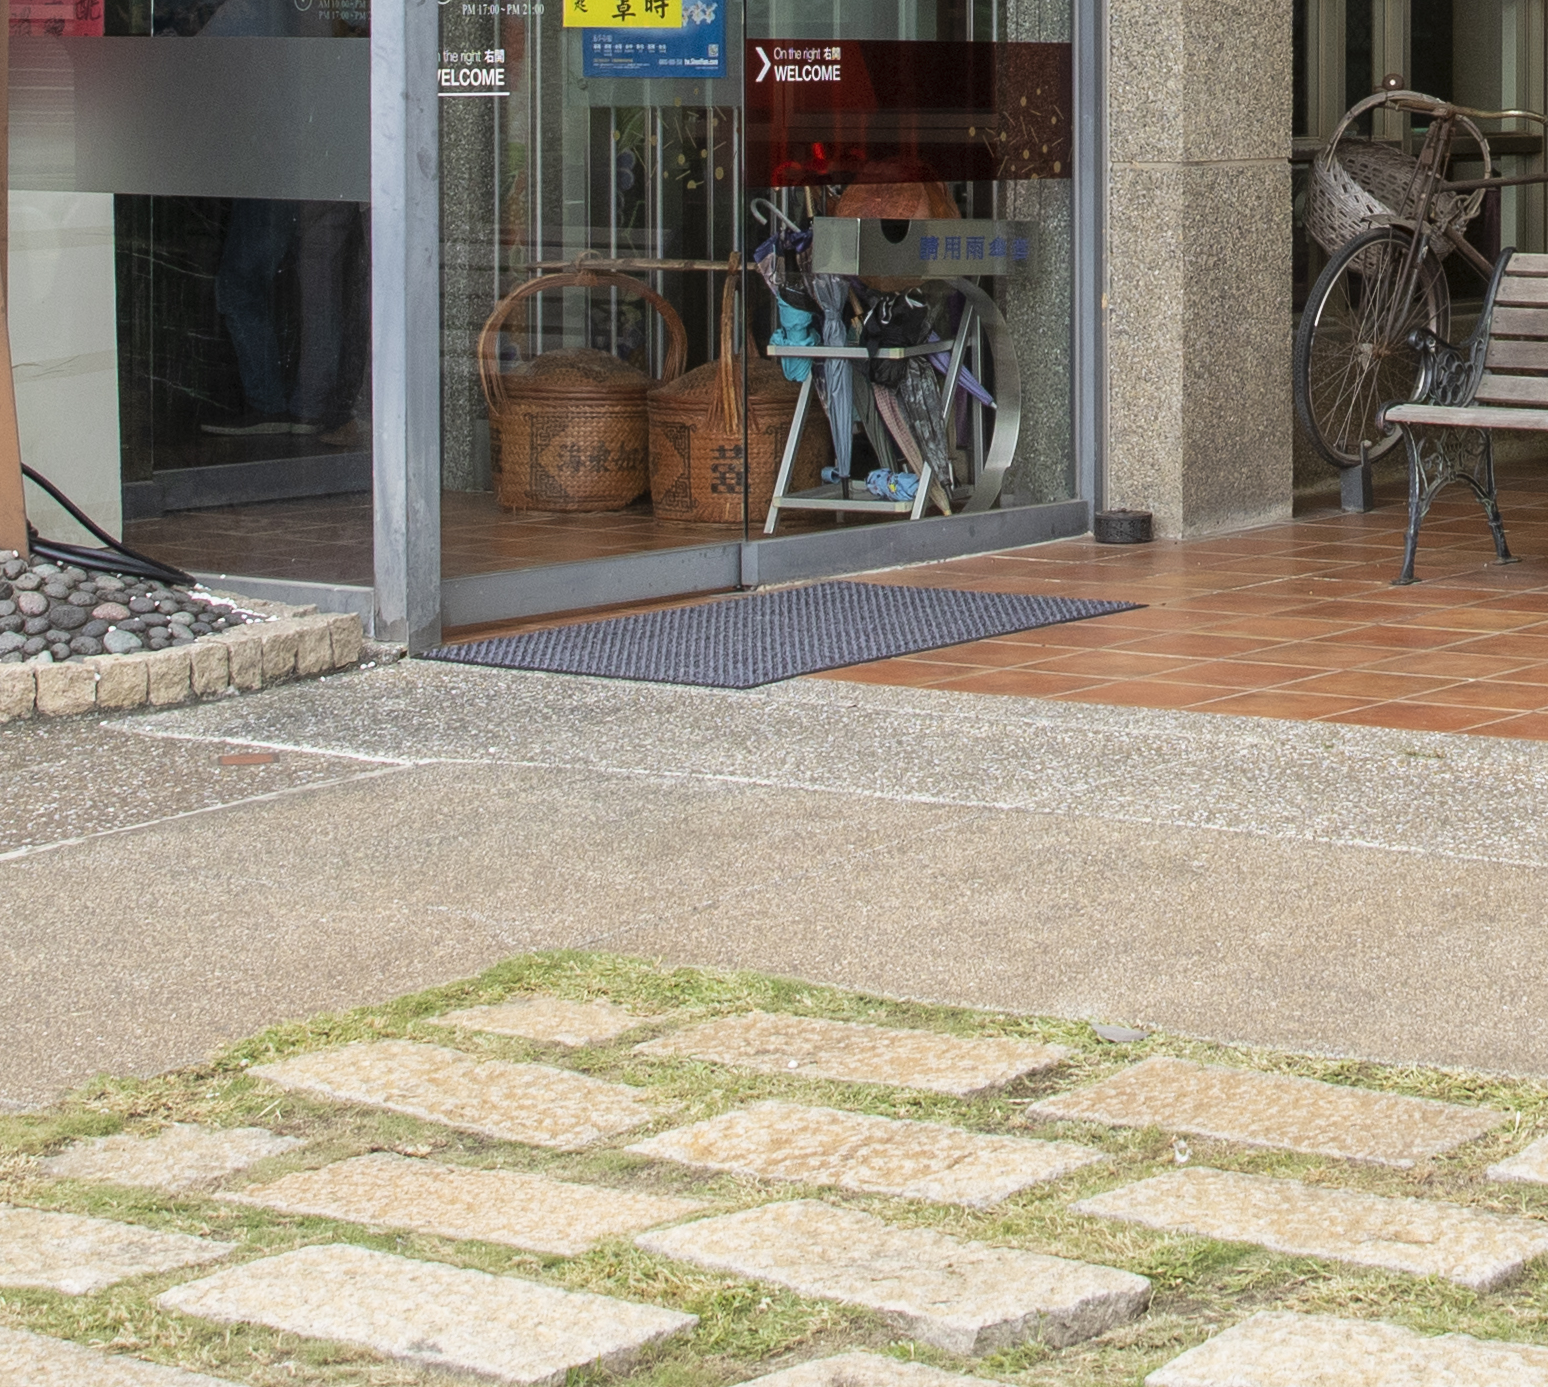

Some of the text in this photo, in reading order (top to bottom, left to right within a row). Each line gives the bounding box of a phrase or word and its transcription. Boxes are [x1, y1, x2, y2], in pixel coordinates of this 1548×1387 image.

[443, 50, 459, 62] the
[460, 49, 482, 65] right
[484, 49, 505, 64] 右開
[773, 47, 841, 62] On the right 右開
[774, 64, 841, 81] WELCOME
